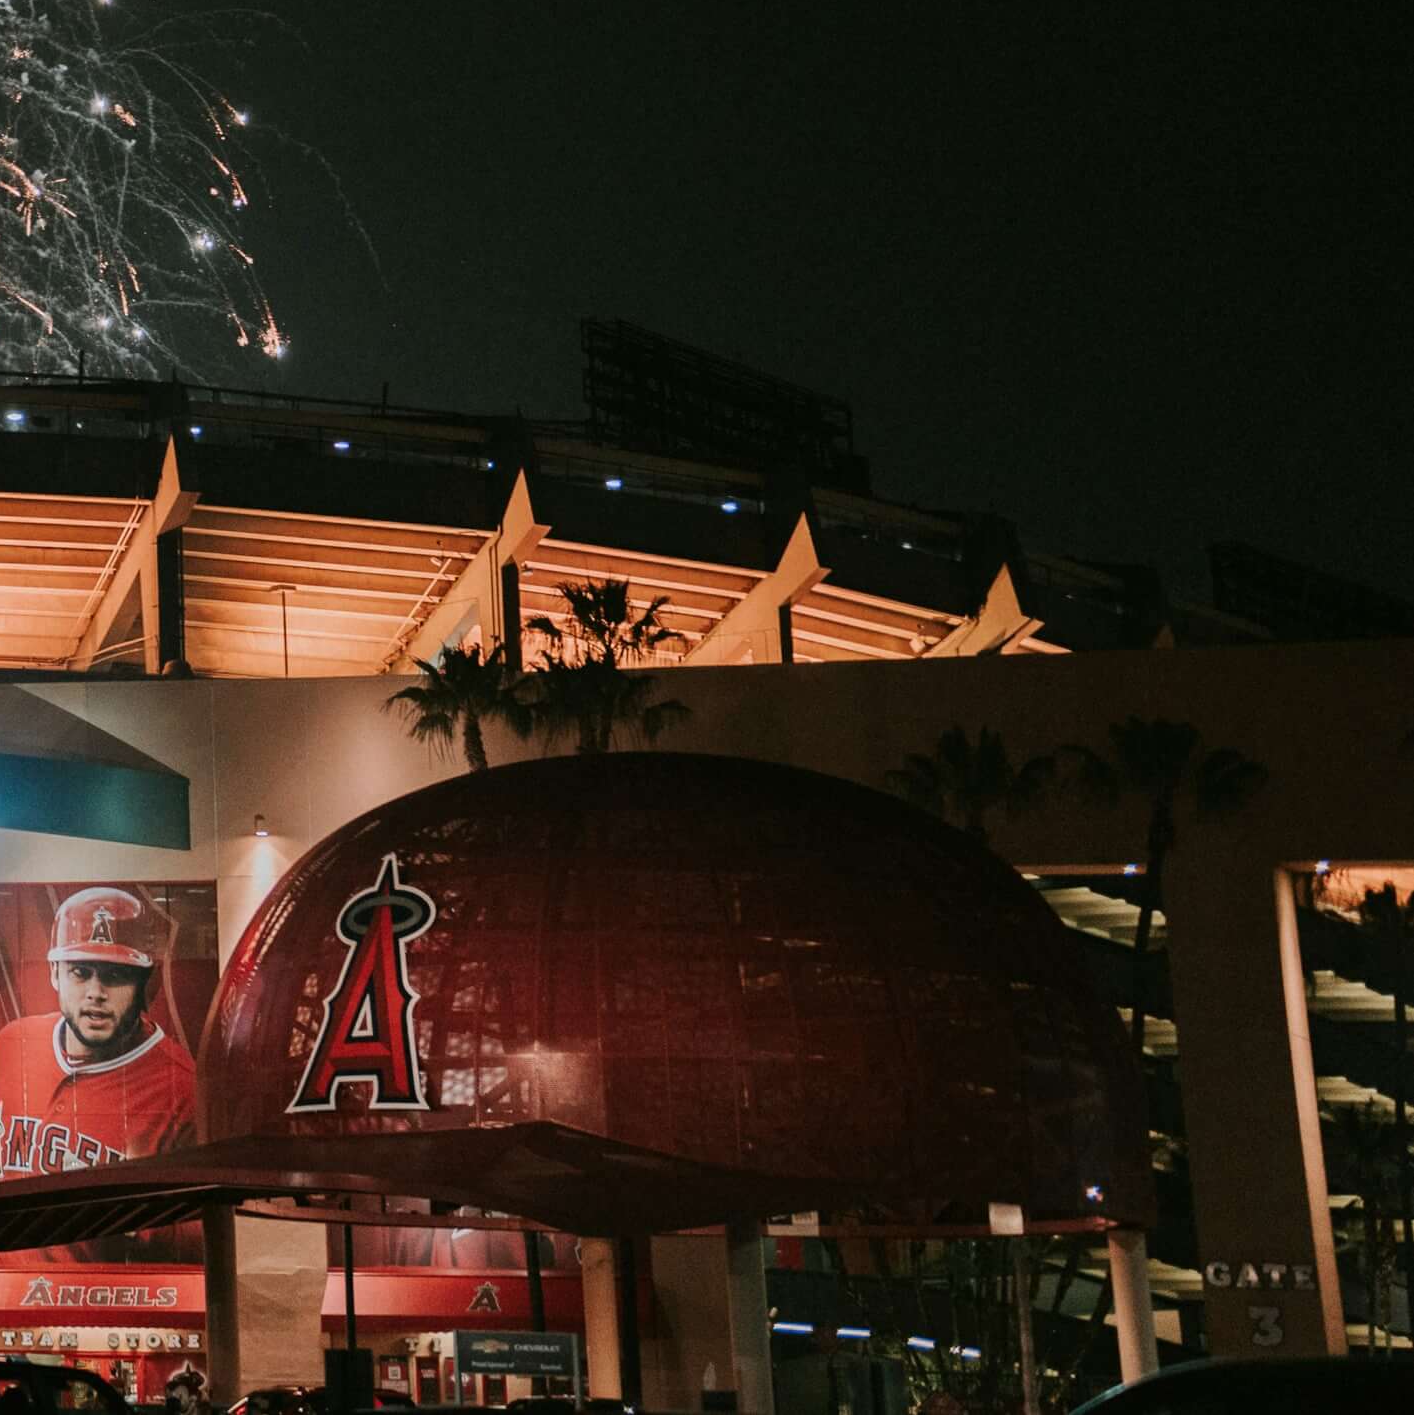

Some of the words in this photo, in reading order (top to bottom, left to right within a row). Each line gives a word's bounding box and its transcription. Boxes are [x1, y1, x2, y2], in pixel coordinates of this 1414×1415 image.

[1205, 1262, 1315, 1290] GATE
[20, 1276, 177, 1306] ANGELS
[2, 1331, 78, 1348] TEAM
[108, 1334, 200, 1349] STORE
[1248, 1306, 1284, 1346] 3
